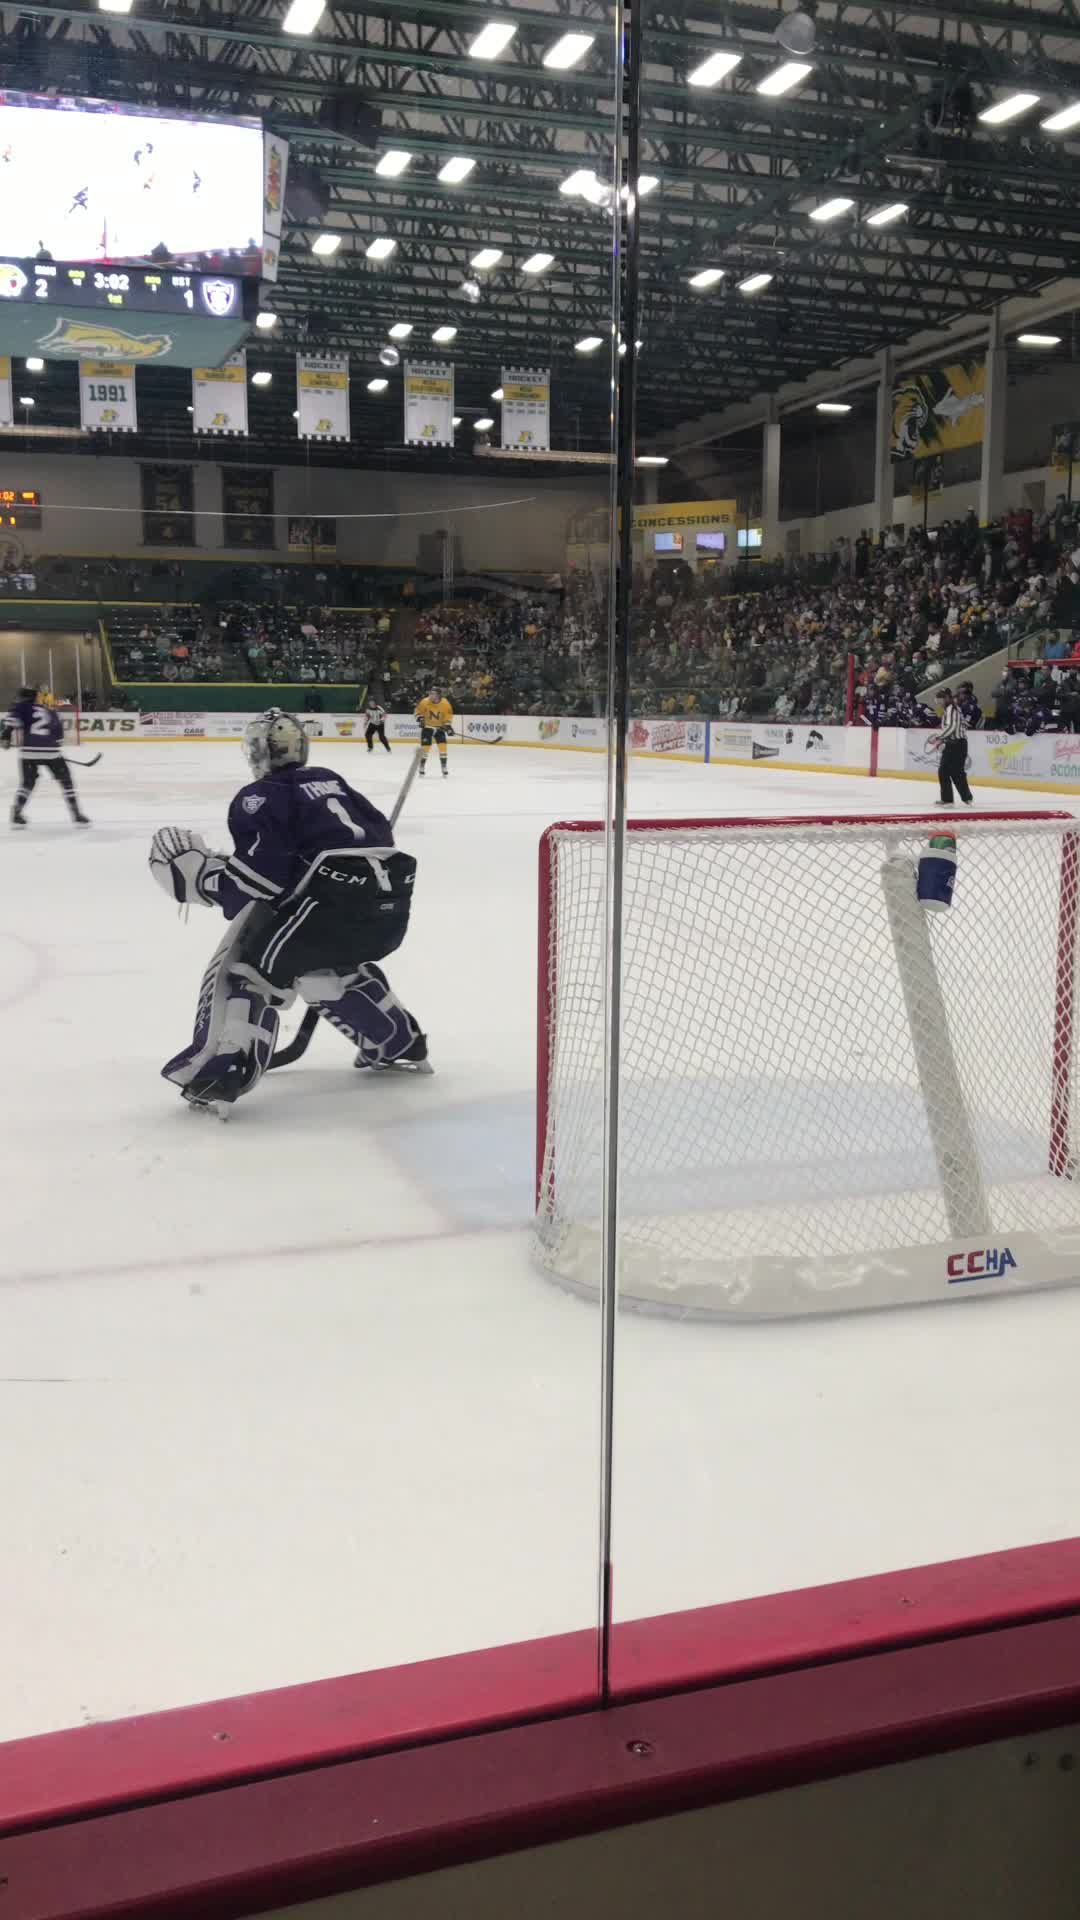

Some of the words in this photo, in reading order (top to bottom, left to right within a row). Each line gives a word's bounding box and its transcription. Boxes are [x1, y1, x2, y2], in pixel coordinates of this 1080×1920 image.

[35, 278, 48, 297] 2
[94, 272, 130, 290] 3:02
[183, 289, 194, 308] 1
[304, 361, 342, 370] HOCKEY
[411, 367, 448, 377] HOCKEY
[88, 383, 127, 403] 1991
[30, 706, 50, 736] 2
[428, 710, 441, 721] N
[985, 734, 1009, 746] 100.3
[326, 797, 366, 841] 1
[317, 865, 368, 886] CCM
[947, 1247, 1018, 1279] CCHA
